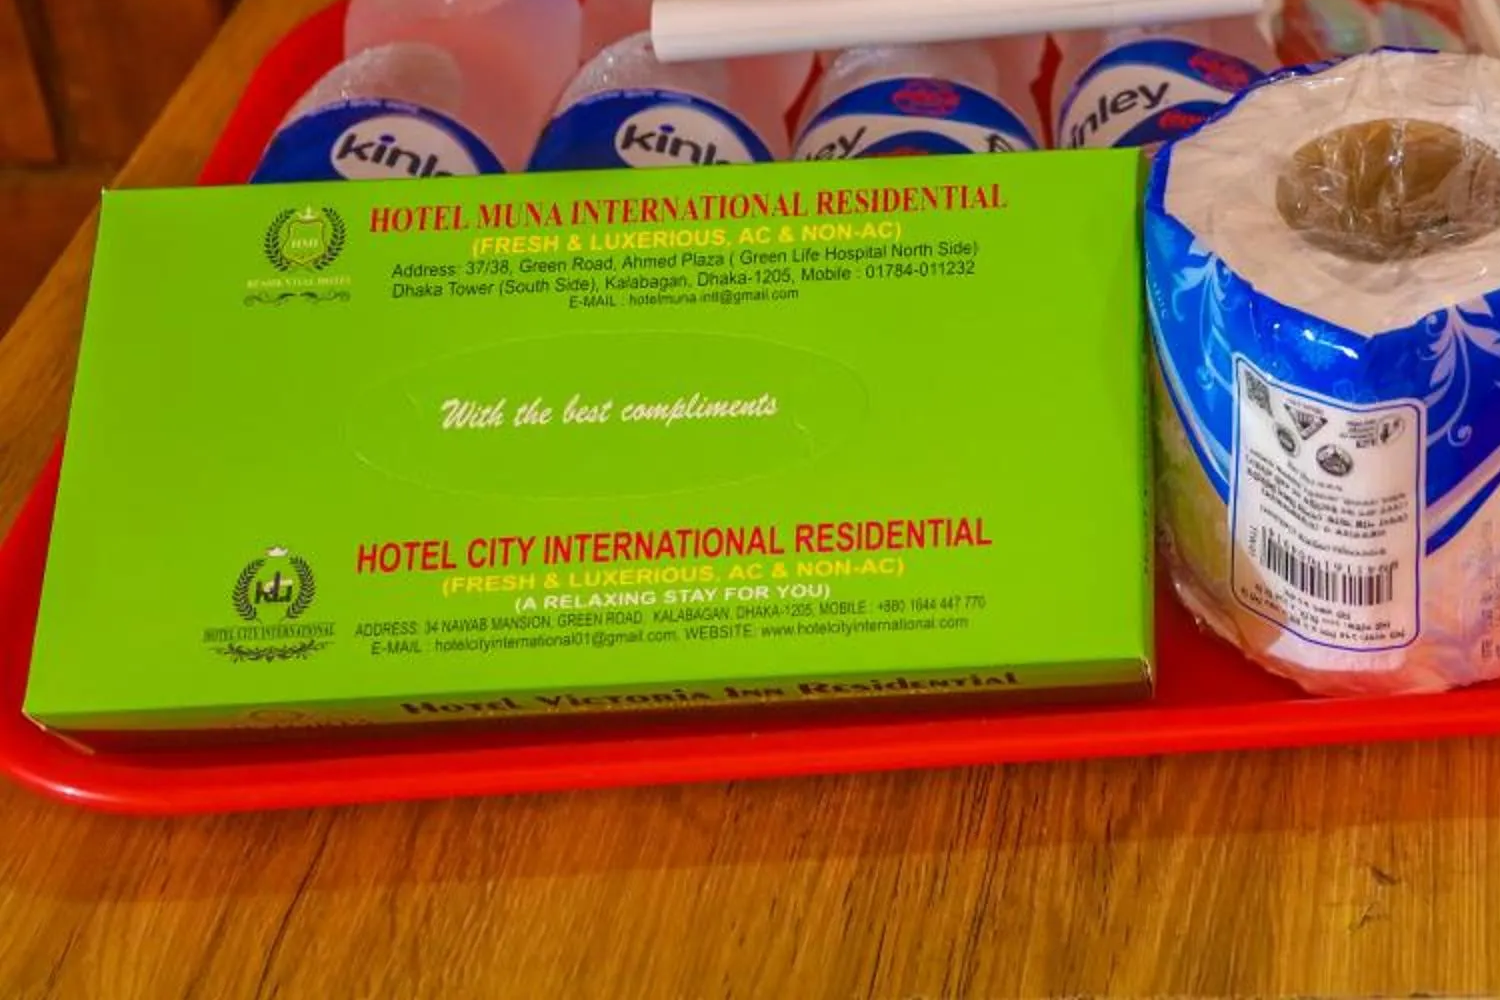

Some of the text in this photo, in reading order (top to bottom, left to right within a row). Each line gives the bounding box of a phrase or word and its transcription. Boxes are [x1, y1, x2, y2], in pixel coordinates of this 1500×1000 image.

[369, 183, 1008, 234] HOTEL MUNA INTERNATIONAL RESIDENTIAL
[465, 259, 513, 276] 37/38,
[519, 257, 567, 273] Green
[572, 255, 617, 272] Road,
[621, 253, 677, 270] Ahmed
[681, 251, 725, 267] Plaza
[791, 247, 821, 263] Life
[824, 244, 887, 264] Hospital
[890, 242, 933, 258] North
[937, 240, 979, 257] Side)
[471, 221, 903, 258] (FRESH & LUXERIOUS, AC & NON-AC)
[391, 281, 444, 299] Dhaka
[447, 279, 494, 297] Tower
[499, 277, 551, 297] (South
[554, 274, 600, 294] Side),
[697, 269, 795, 288] Dhaka-1205,
[864, 259, 976, 279] 01784-011232
[568, 294, 617, 310] E-MAIL
[441, 391, 780, 430] With the best compliments
[356, 517, 993, 574] HOTEL CITY INTERNATIONAL RESIDENTIAL
[442, 556, 906, 598] (FRESH & LUXERIOUS, AC & NON-AC)
[514, 581, 831, 615] (A RELAXING STAY FOR YOU)
[441, 617, 488, 633] NAWAB
[557, 611, 604, 628] GREEN
[370, 639, 423, 656] E-MAIL
